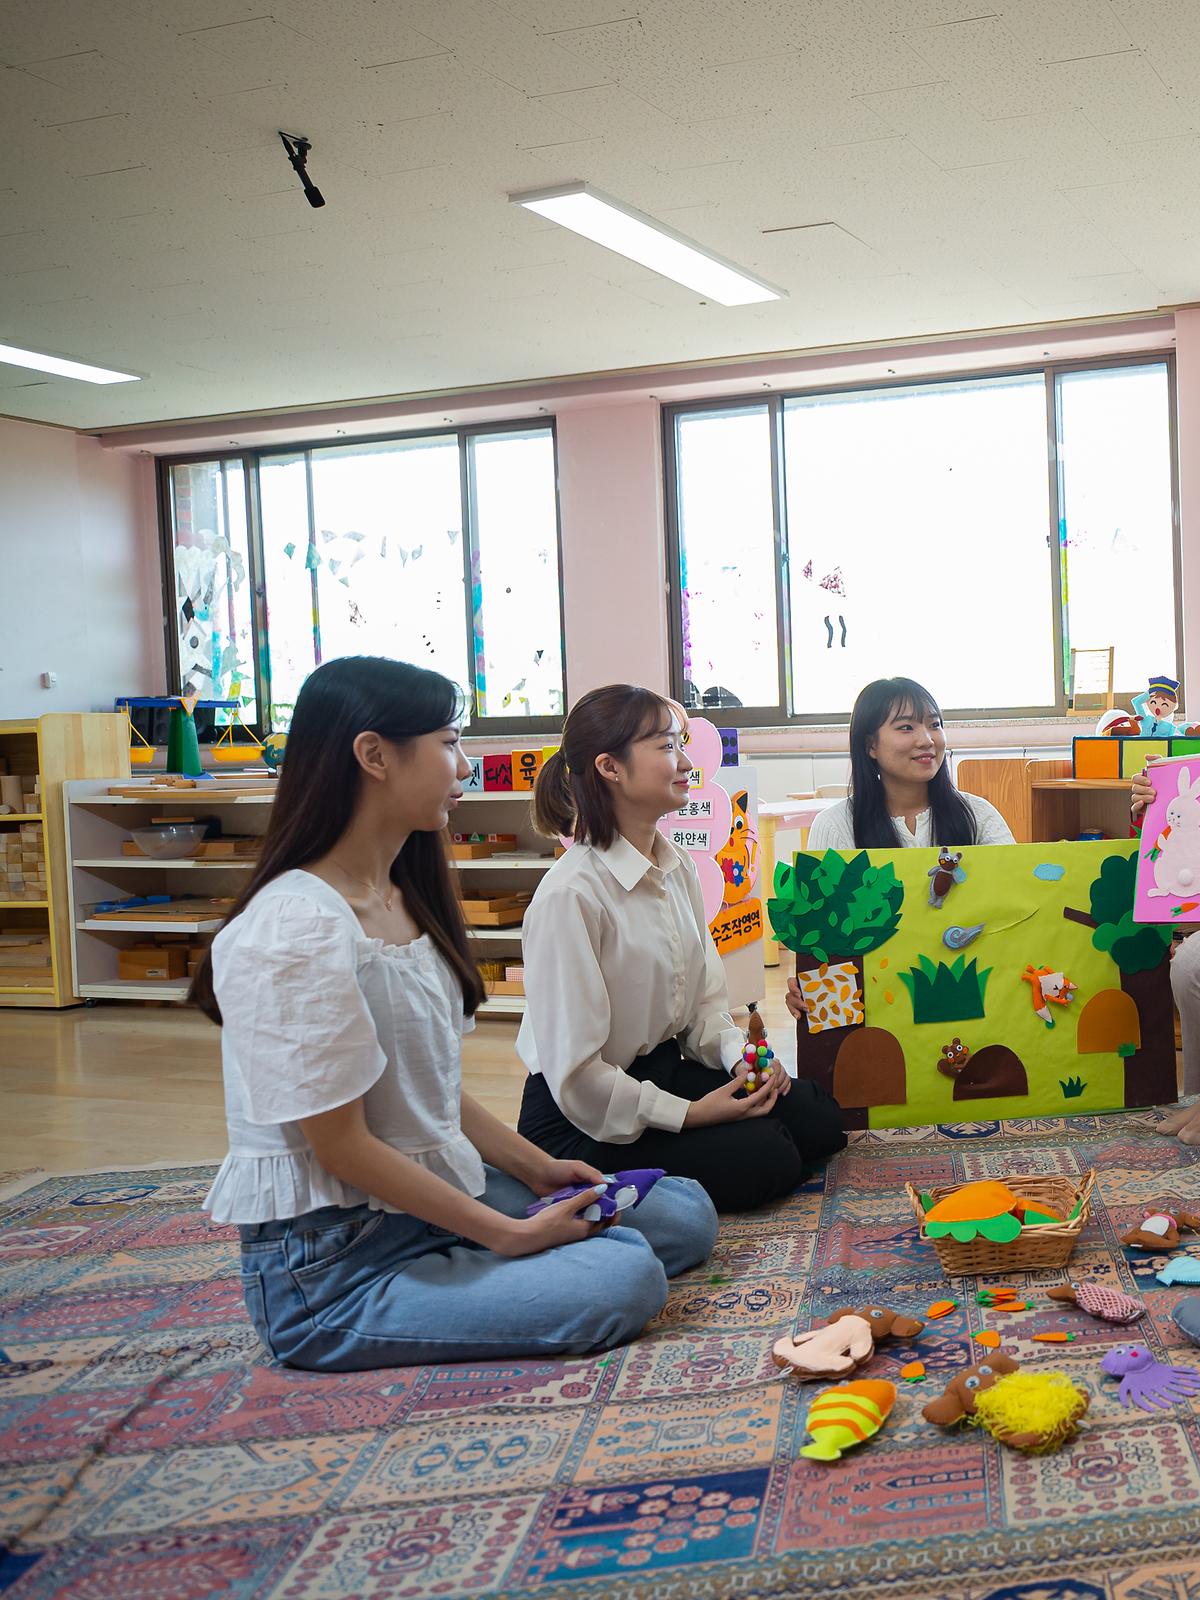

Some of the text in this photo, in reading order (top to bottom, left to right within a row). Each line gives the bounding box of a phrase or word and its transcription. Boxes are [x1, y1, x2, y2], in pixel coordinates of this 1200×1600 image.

[519, 753, 537, 789] 육
[673, 831, 707, 847] 하얀색
[710, 909, 761, 948] 수조작영역
